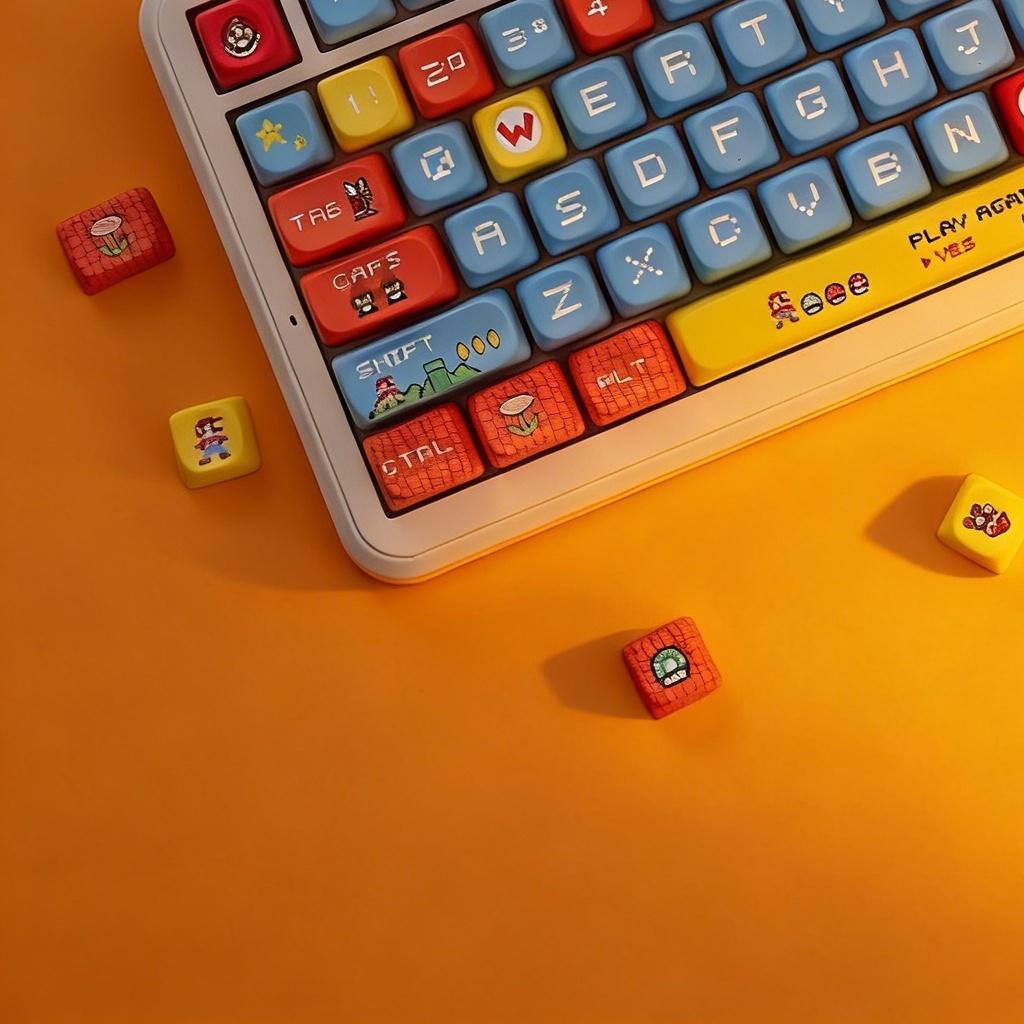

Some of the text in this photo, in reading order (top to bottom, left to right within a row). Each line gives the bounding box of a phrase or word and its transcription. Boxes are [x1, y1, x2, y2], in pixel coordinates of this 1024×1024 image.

[740, 13, 768, 48] T
[955, 19, 980, 55] J
[660, 49, 697, 85] R
[872, 50, 910, 88] H
[579, 80, 616, 117] E
[795, 85, 828, 120] G
[496, 111, 535, 148] W
[710, 116, 740, 155] F
[944, 114, 981, 153] N
[632, 152, 667, 188] D
[866, 151, 901, 187] B
[556, 189, 587, 226] S
[787, 182, 820, 217] V
[471, 219, 508, 256] A
[708, 213, 741, 247] C
[624, 247, 664, 285] X
[543, 280, 582, 320] Z
